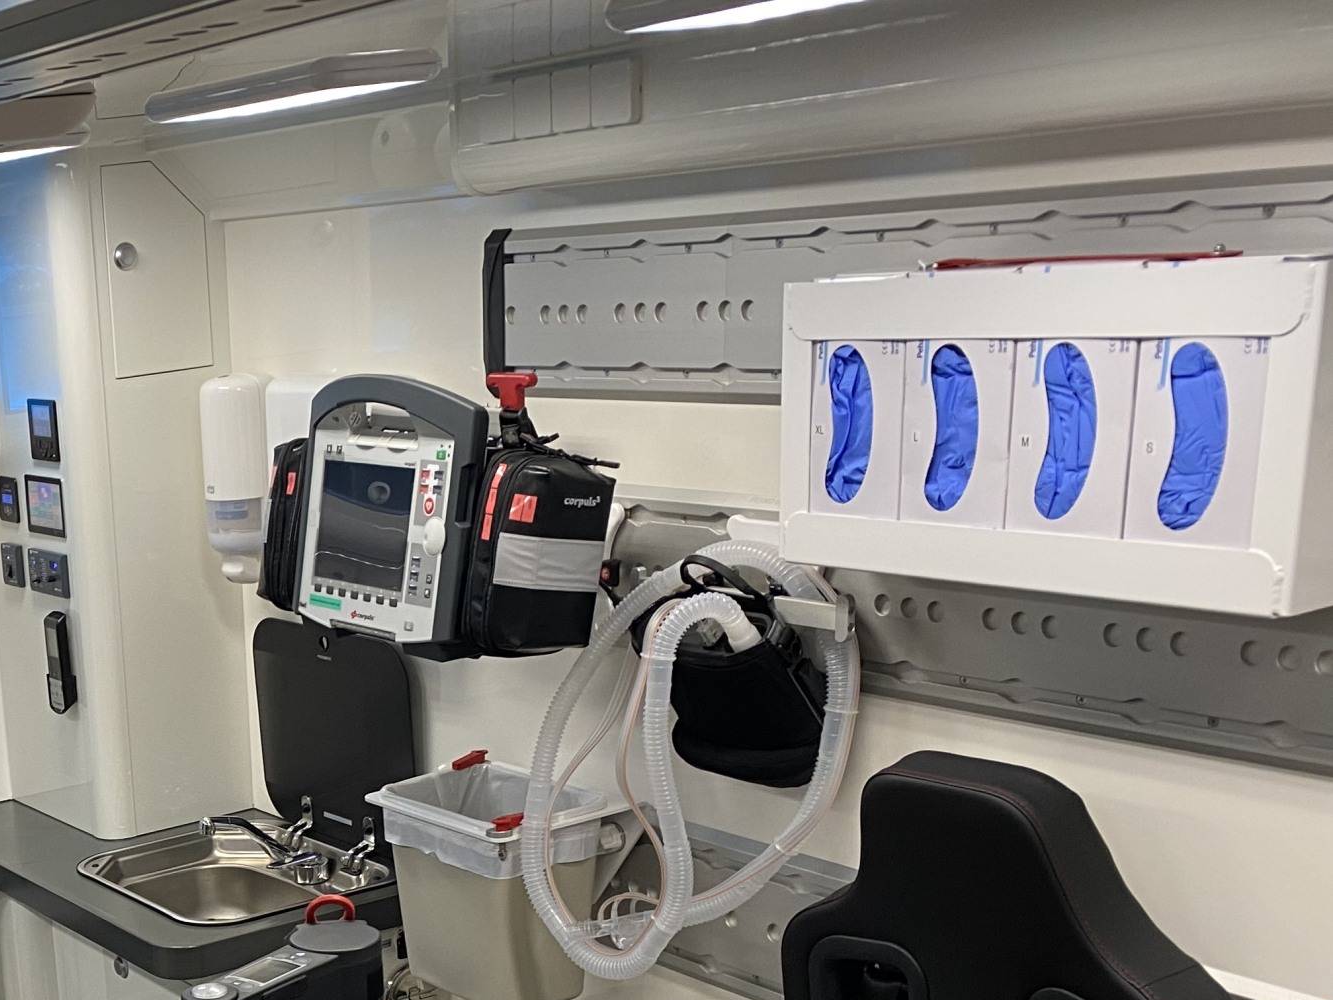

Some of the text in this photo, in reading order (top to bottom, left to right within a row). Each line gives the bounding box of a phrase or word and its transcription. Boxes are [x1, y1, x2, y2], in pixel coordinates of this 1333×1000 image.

[816, 425, 824, 434] XL
[913, 433, 918, 442] L
[1022, 437, 1029, 447] M
[1146, 442, 1153, 453] S
